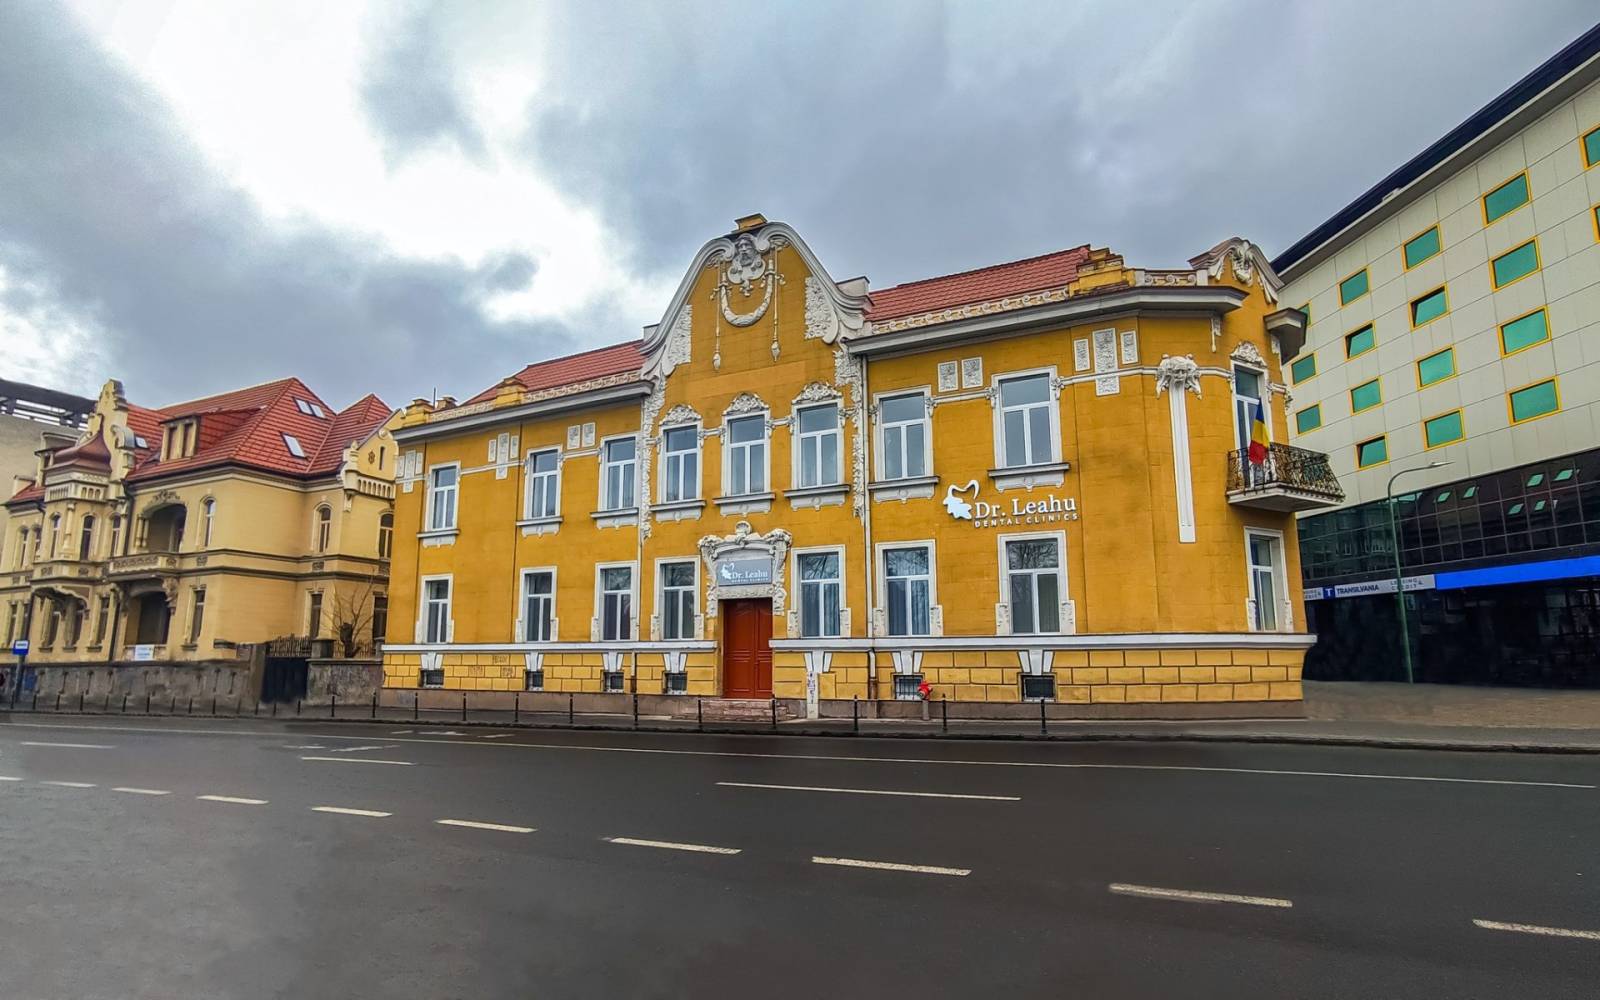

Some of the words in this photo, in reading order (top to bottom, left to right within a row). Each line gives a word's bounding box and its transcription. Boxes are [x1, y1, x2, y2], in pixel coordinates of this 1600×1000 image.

[974, 502, 1006, 519] Dr.
[1011, 494, 1076, 516] Leahu
[974, 517, 1021, 528] DENTAL
[1026, 513, 1079, 523] CLINICS
[1336, 584, 1380, 595] TRANSILVANIA
